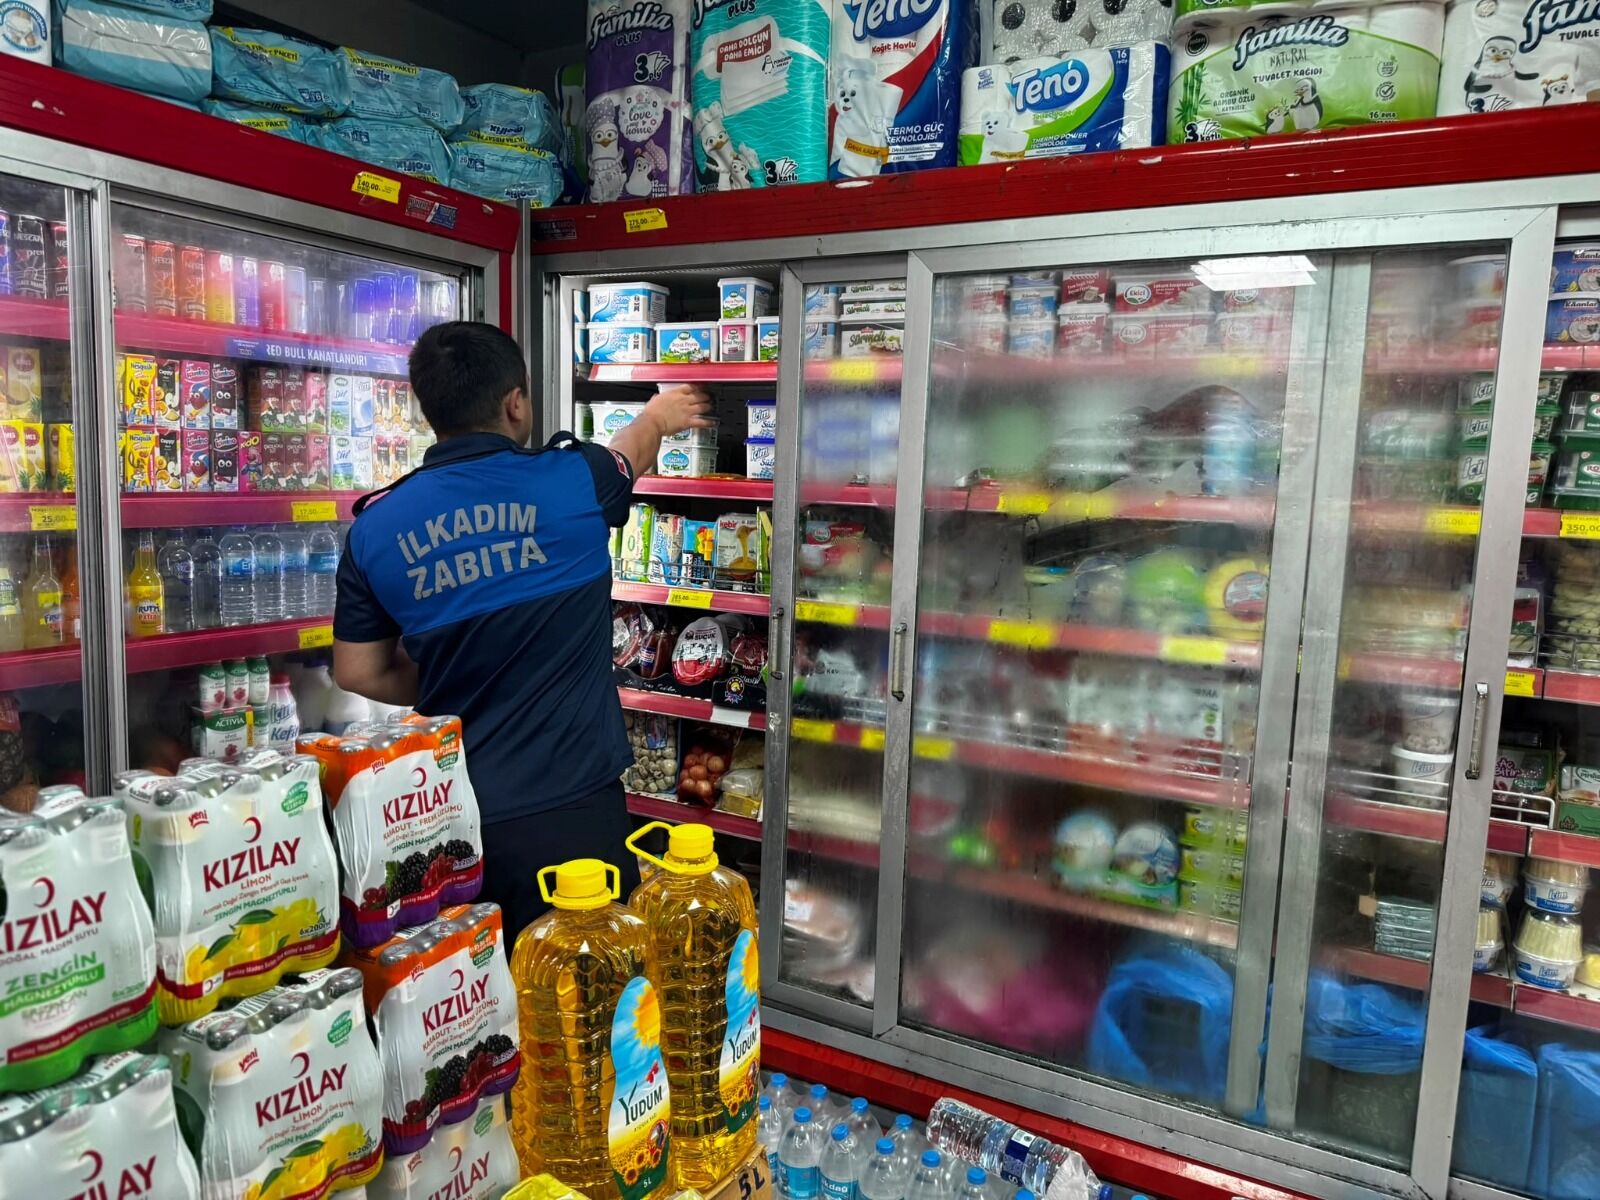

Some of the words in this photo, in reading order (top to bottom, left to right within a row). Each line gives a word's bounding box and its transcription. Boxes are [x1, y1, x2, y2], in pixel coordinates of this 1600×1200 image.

[728, 0, 756, 19] PLUS
[590, 2, 673, 50] familia
[738, 30, 769, 47] DOLGUN
[893, 40, 917, 50] Havlu
[1117, 50, 1127, 59] 16
[1233, 15, 1349, 71] familia
[635, 54, 649, 81] 3
[1252, 70, 1291, 83] TUVALET
[1293, 67, 1323, 78] KAĞIDI
[888, 125, 921, 135] TERMO
[923, 121, 944, 133] GÜÇ
[1185, 123, 1199, 142] 3
[765, 160, 777, 184] 3
[284, 346, 306, 360] BULL
[397, 502, 537, 564] İLKADIM
[407, 536, 548, 600] ZABITA
[188, 808, 208, 824] yeni
[383, 779, 453, 828] KIZILAY
[203, 837, 301, 893] KIZILAY
[240, 873, 272, 890] LİMON
[5, 951, 98, 995] ZENGİN
[4, 968, 98, 1012] MAGNEZYUMLU
[422, 972, 490, 1037] KIZILAY
[728, 1023, 757, 1065] YUDUM
[239, 1048, 258, 1071] yeni
[256, 1062, 348, 1128] KIZILAY
[618, 1080, 663, 1126] YUDUM
